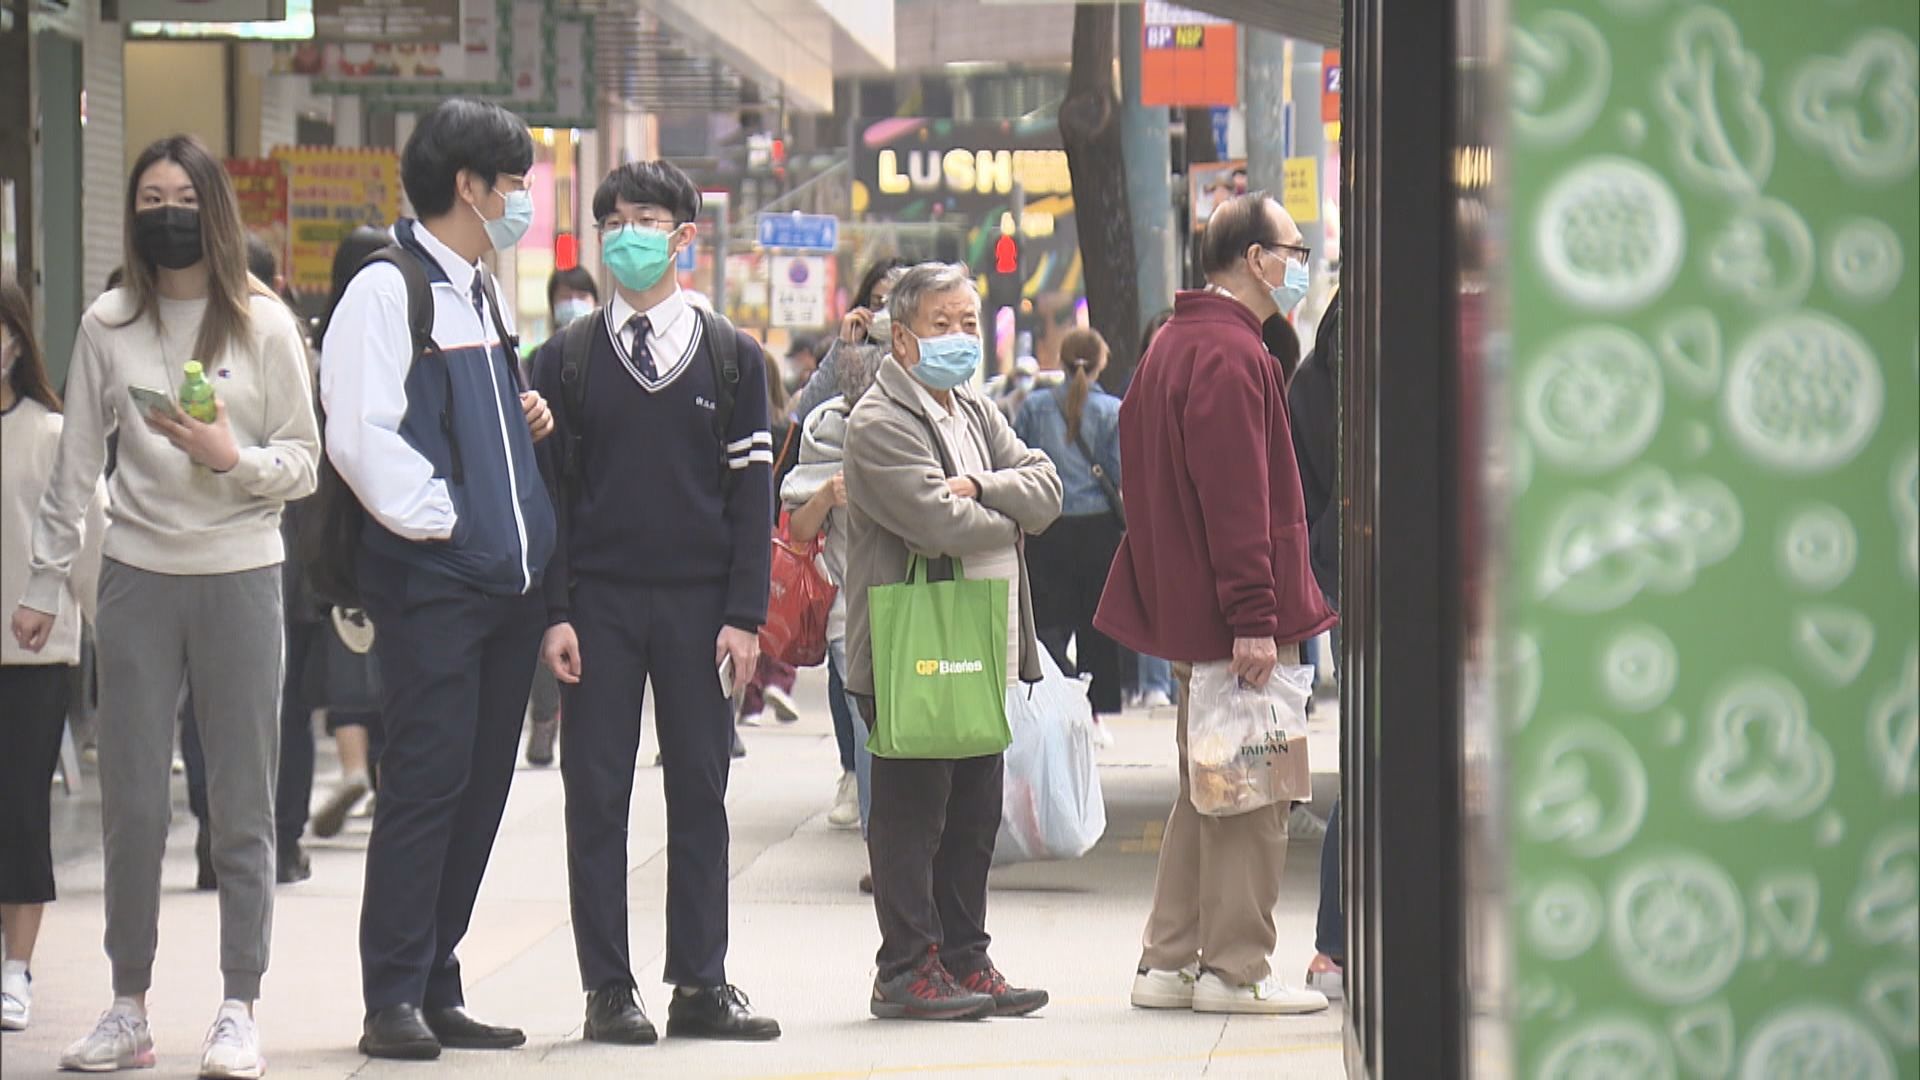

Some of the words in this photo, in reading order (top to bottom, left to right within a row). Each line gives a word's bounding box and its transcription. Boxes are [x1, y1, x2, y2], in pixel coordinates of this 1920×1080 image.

[879, 149, 1012, 193] LUSH
[916, 660, 938, 675] GP
[1241, 744, 1288, 755] TAIPAN
